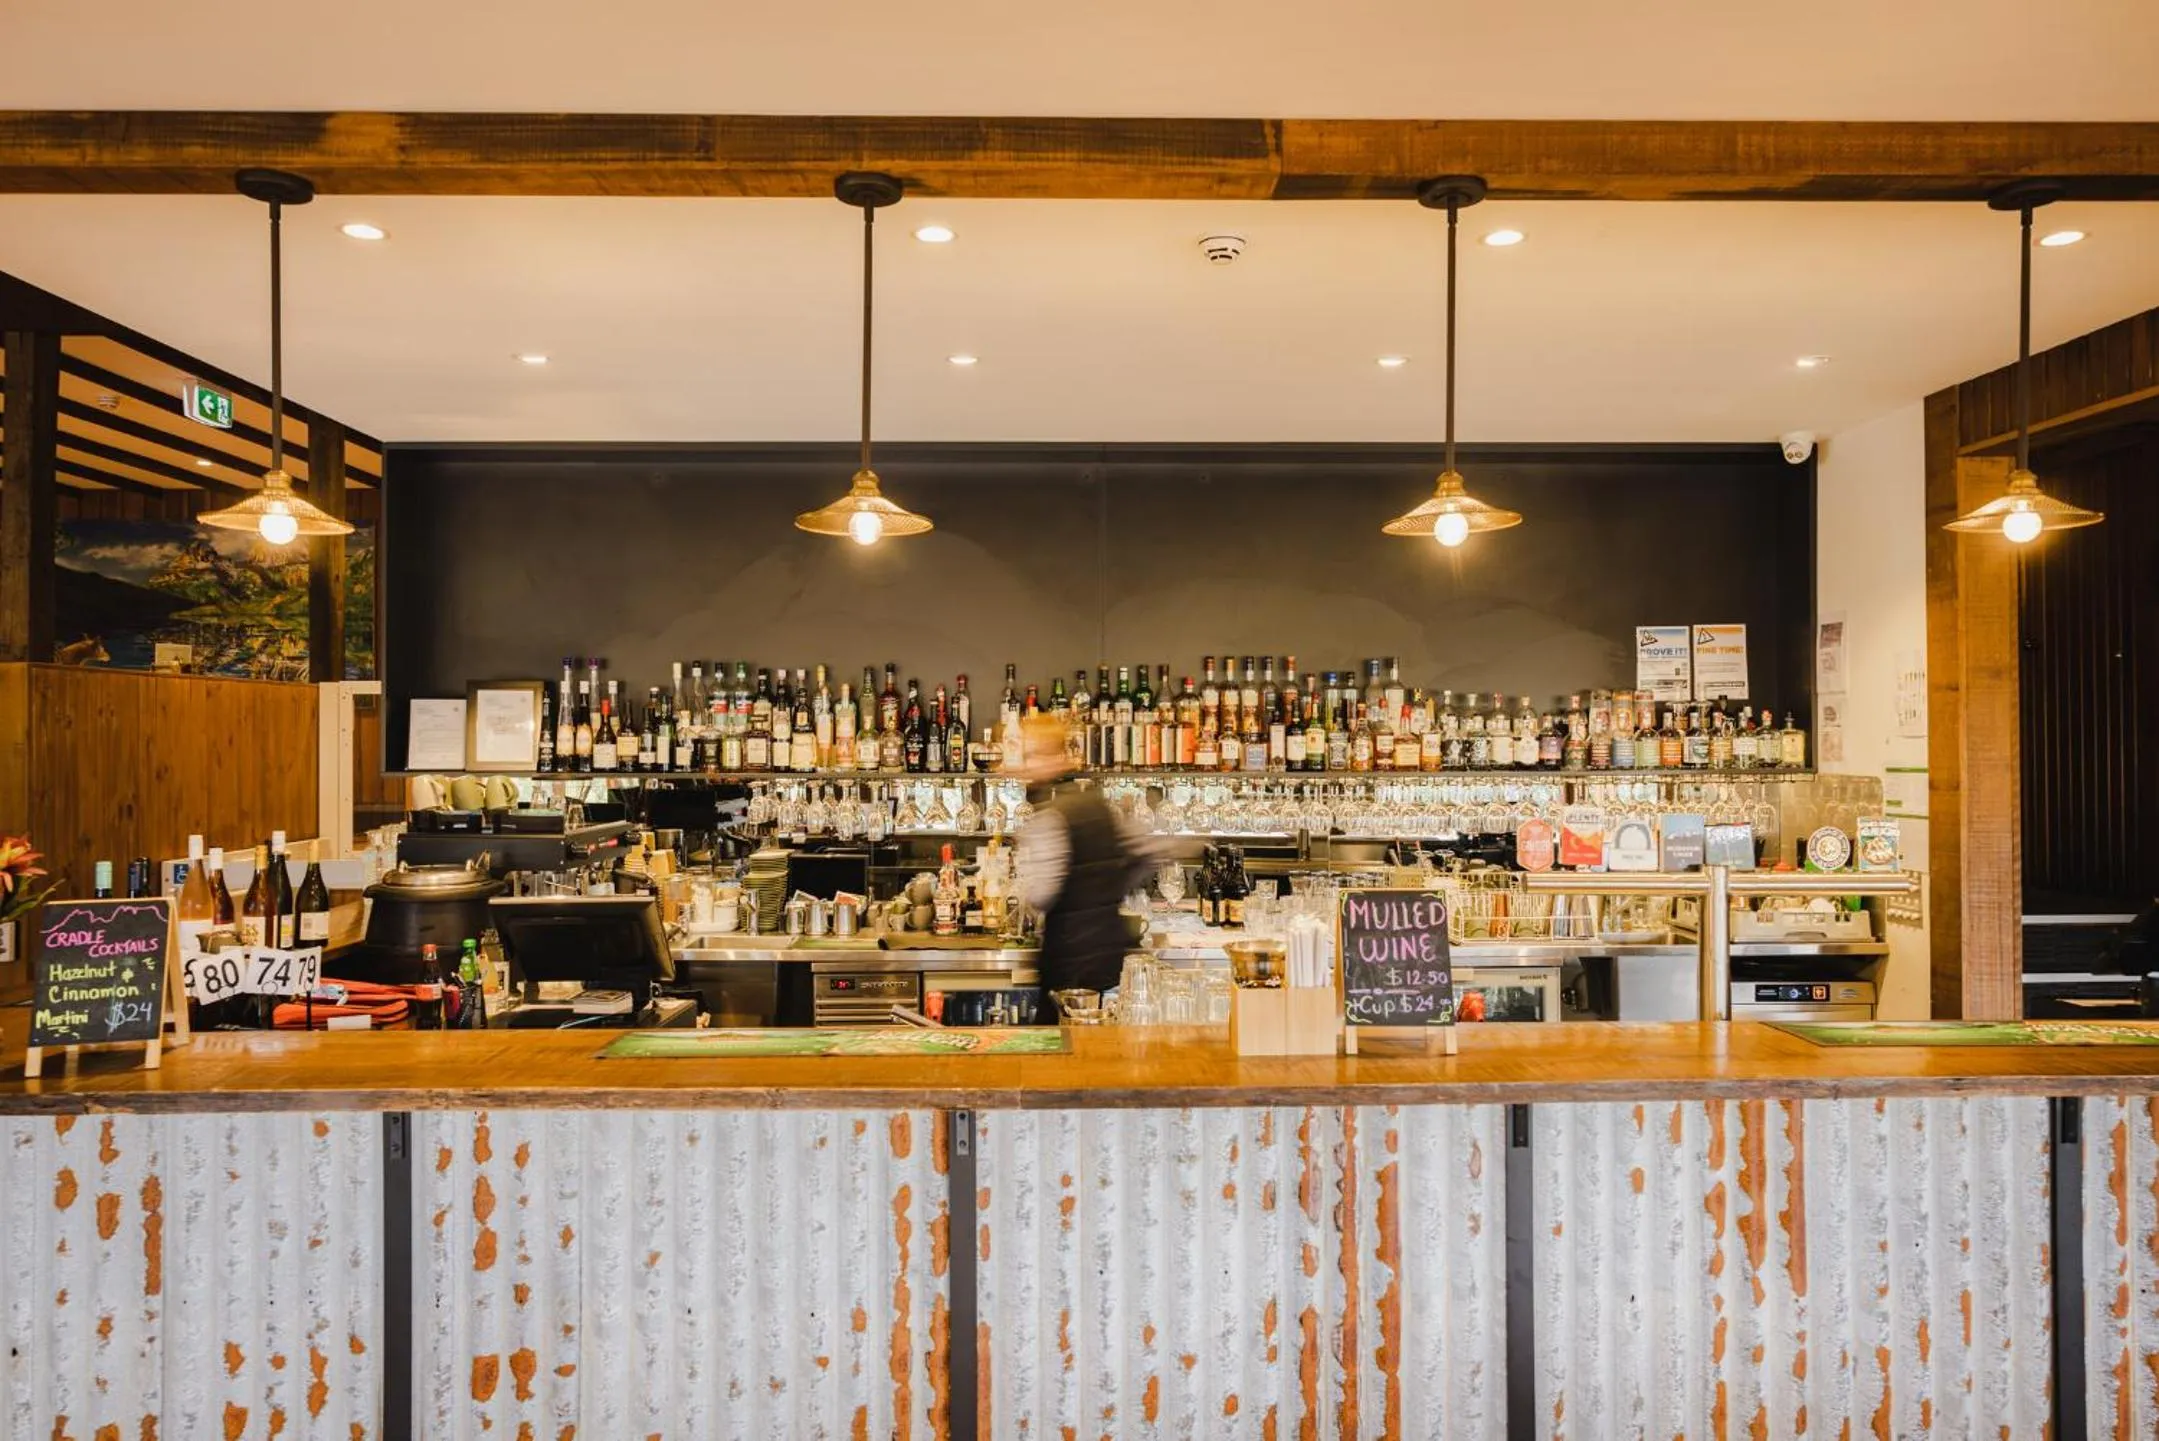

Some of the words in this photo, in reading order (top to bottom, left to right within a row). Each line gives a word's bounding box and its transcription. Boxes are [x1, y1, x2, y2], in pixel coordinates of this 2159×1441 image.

[1349, 899, 1446, 930] MULLED
[45, 929, 107, 948] CRADLE
[88, 937, 159, 957] COCKTAILS
[1359, 932, 1437, 963] WINE
[49, 960, 118, 981] Hazelnut
[203, 959, 240, 994] 80
[257, 957, 292, 987] 74
[298, 955, 316, 985] 79
[48, 985, 140, 1004] Cinnamon
[35, 1008, 90, 1029] Martini
